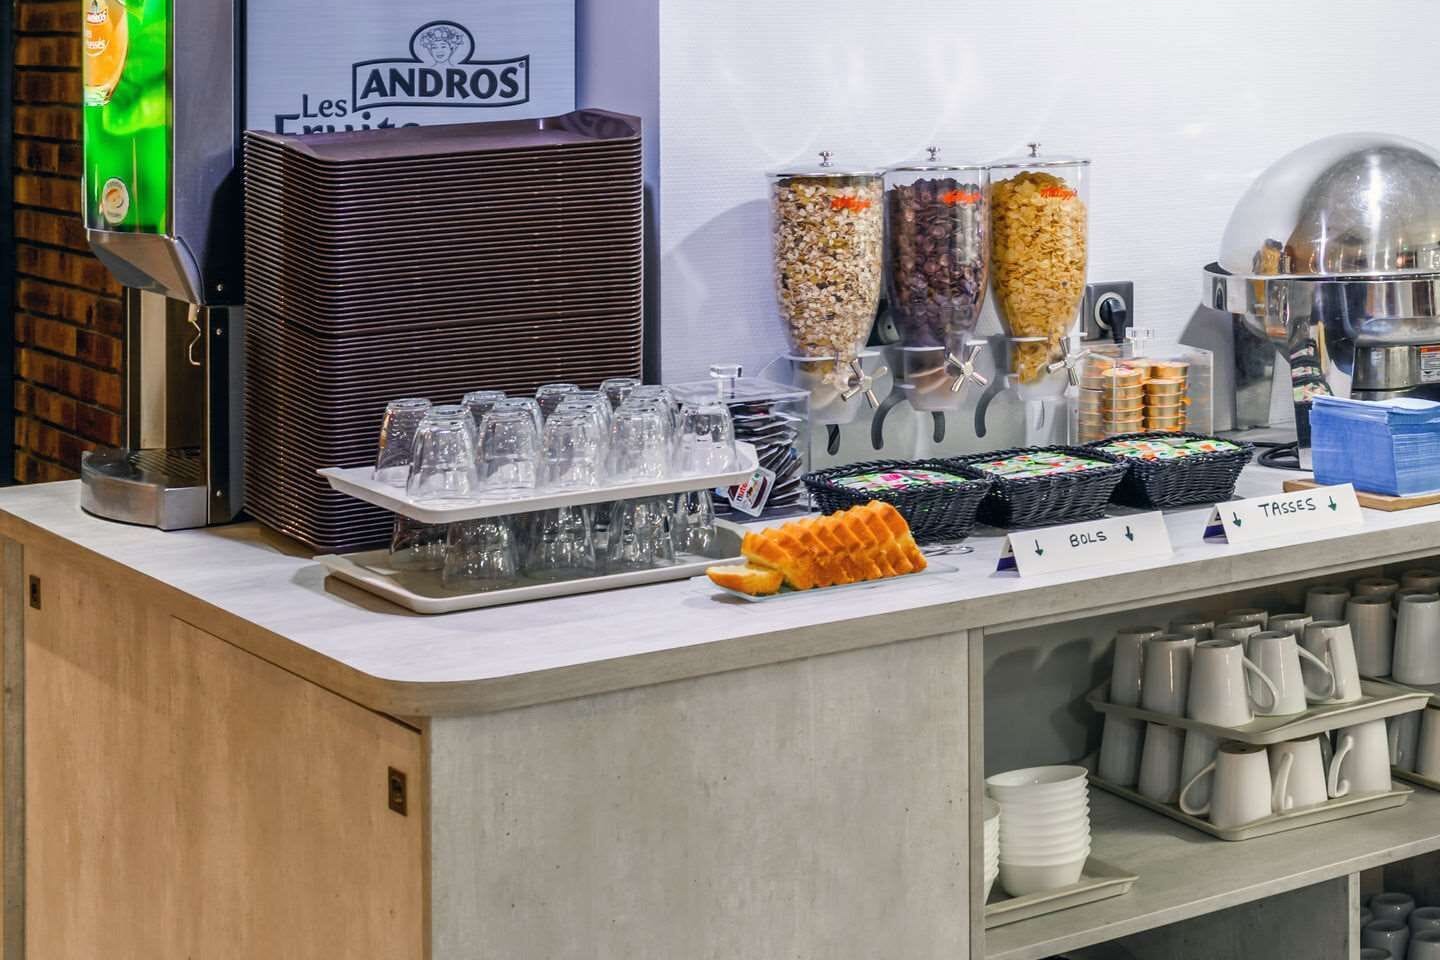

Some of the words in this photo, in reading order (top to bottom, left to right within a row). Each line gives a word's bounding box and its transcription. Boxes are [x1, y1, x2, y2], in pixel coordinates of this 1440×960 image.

[360, 66, 520, 100] ANDROS
[302, 94, 348, 118] Les
[1258, 497, 1317, 518] TASSES
[1069, 530, 1108, 548] BOLS
